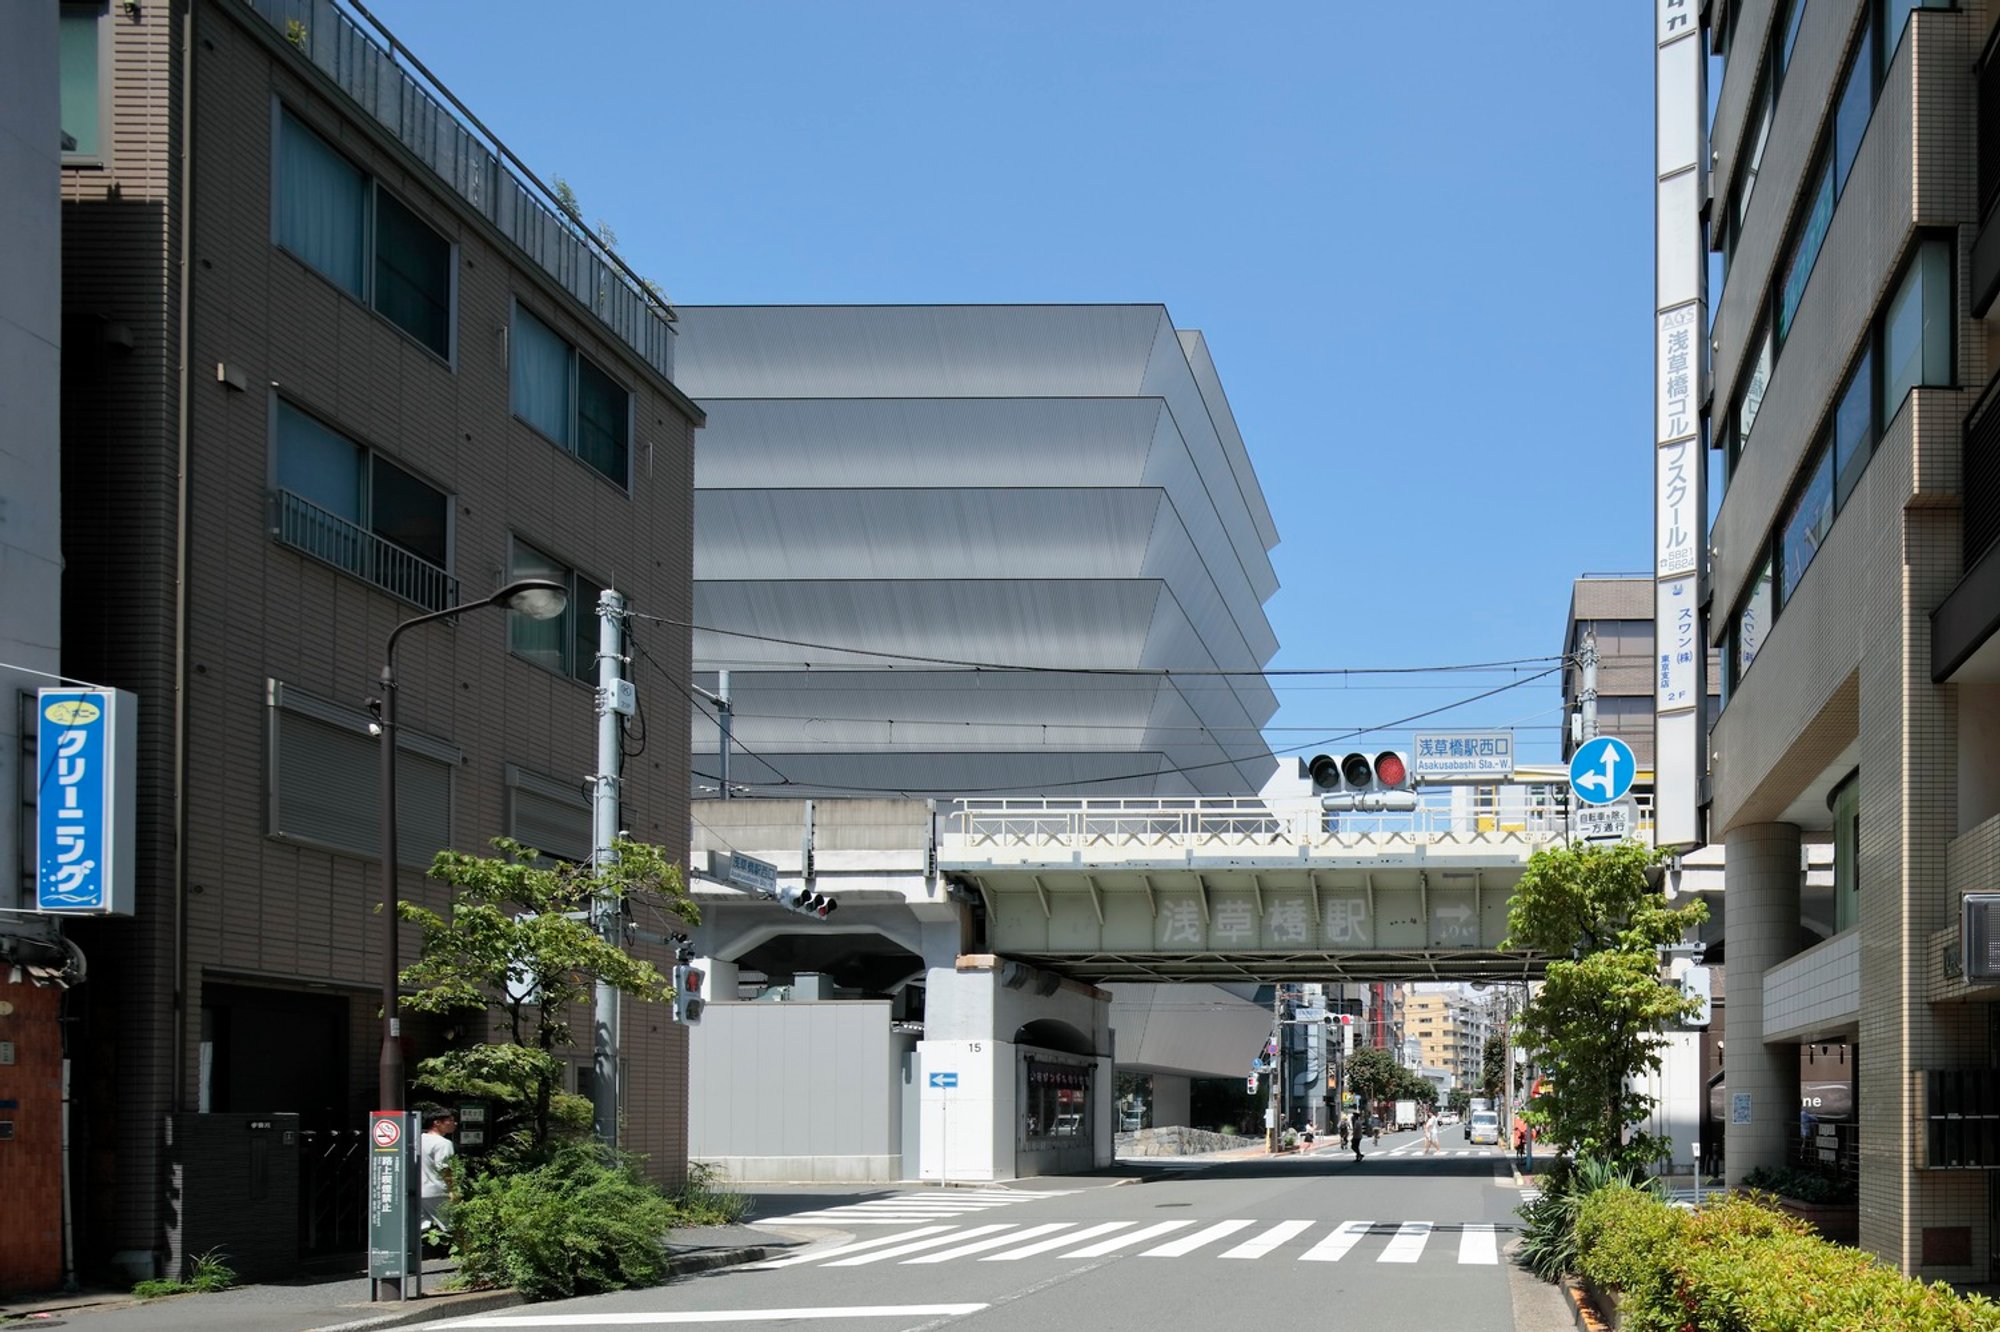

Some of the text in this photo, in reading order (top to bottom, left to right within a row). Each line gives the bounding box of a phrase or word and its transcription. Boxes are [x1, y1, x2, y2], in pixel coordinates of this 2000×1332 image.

[1660, 655, 1670, 688] 東京支店
[1419, 738, 1508, 757] 浅草橋駅西口
[1418, 759, 1476, 770] Asakusabashi
[57, 730, 95, 892] クリーニング
[1580, 811, 1626, 824] 自転車を除く
[1580, 822, 1625, 834] 一方通行
[1162, 899, 1367, 943] 浅草橋駅
[969, 1042, 982, 1053] 15
